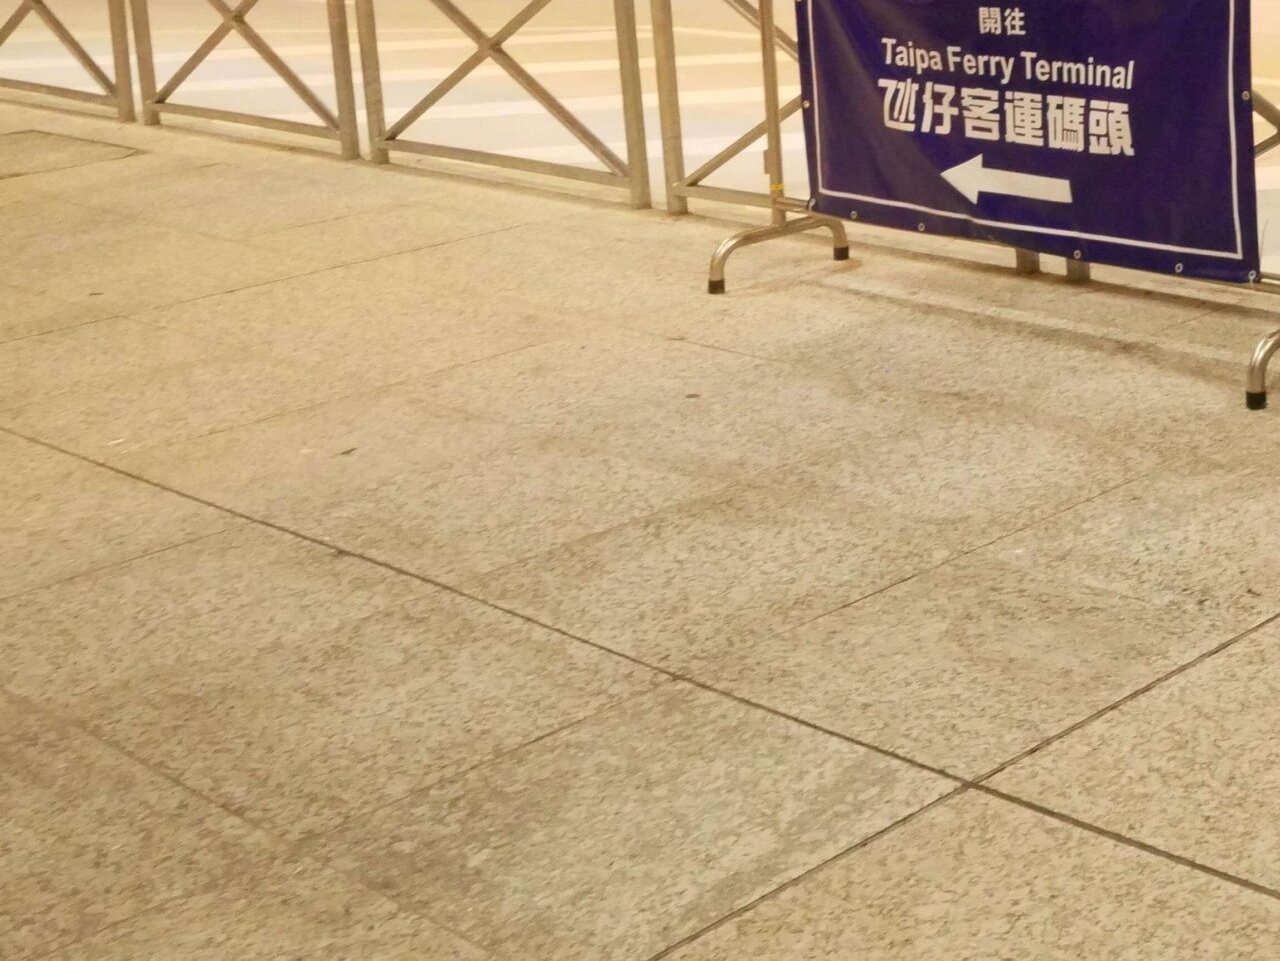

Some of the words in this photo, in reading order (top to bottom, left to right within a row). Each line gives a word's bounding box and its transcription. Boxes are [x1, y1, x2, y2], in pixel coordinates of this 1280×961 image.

[979, 7, 1025, 35] 開往
[882, 38, 942, 74] Taipa
[947, 46, 1014, 84] Ferry
[1019, 51, 1135, 90] Terminal
[878, 78, 1134, 156] 氹仔客運碼頭
